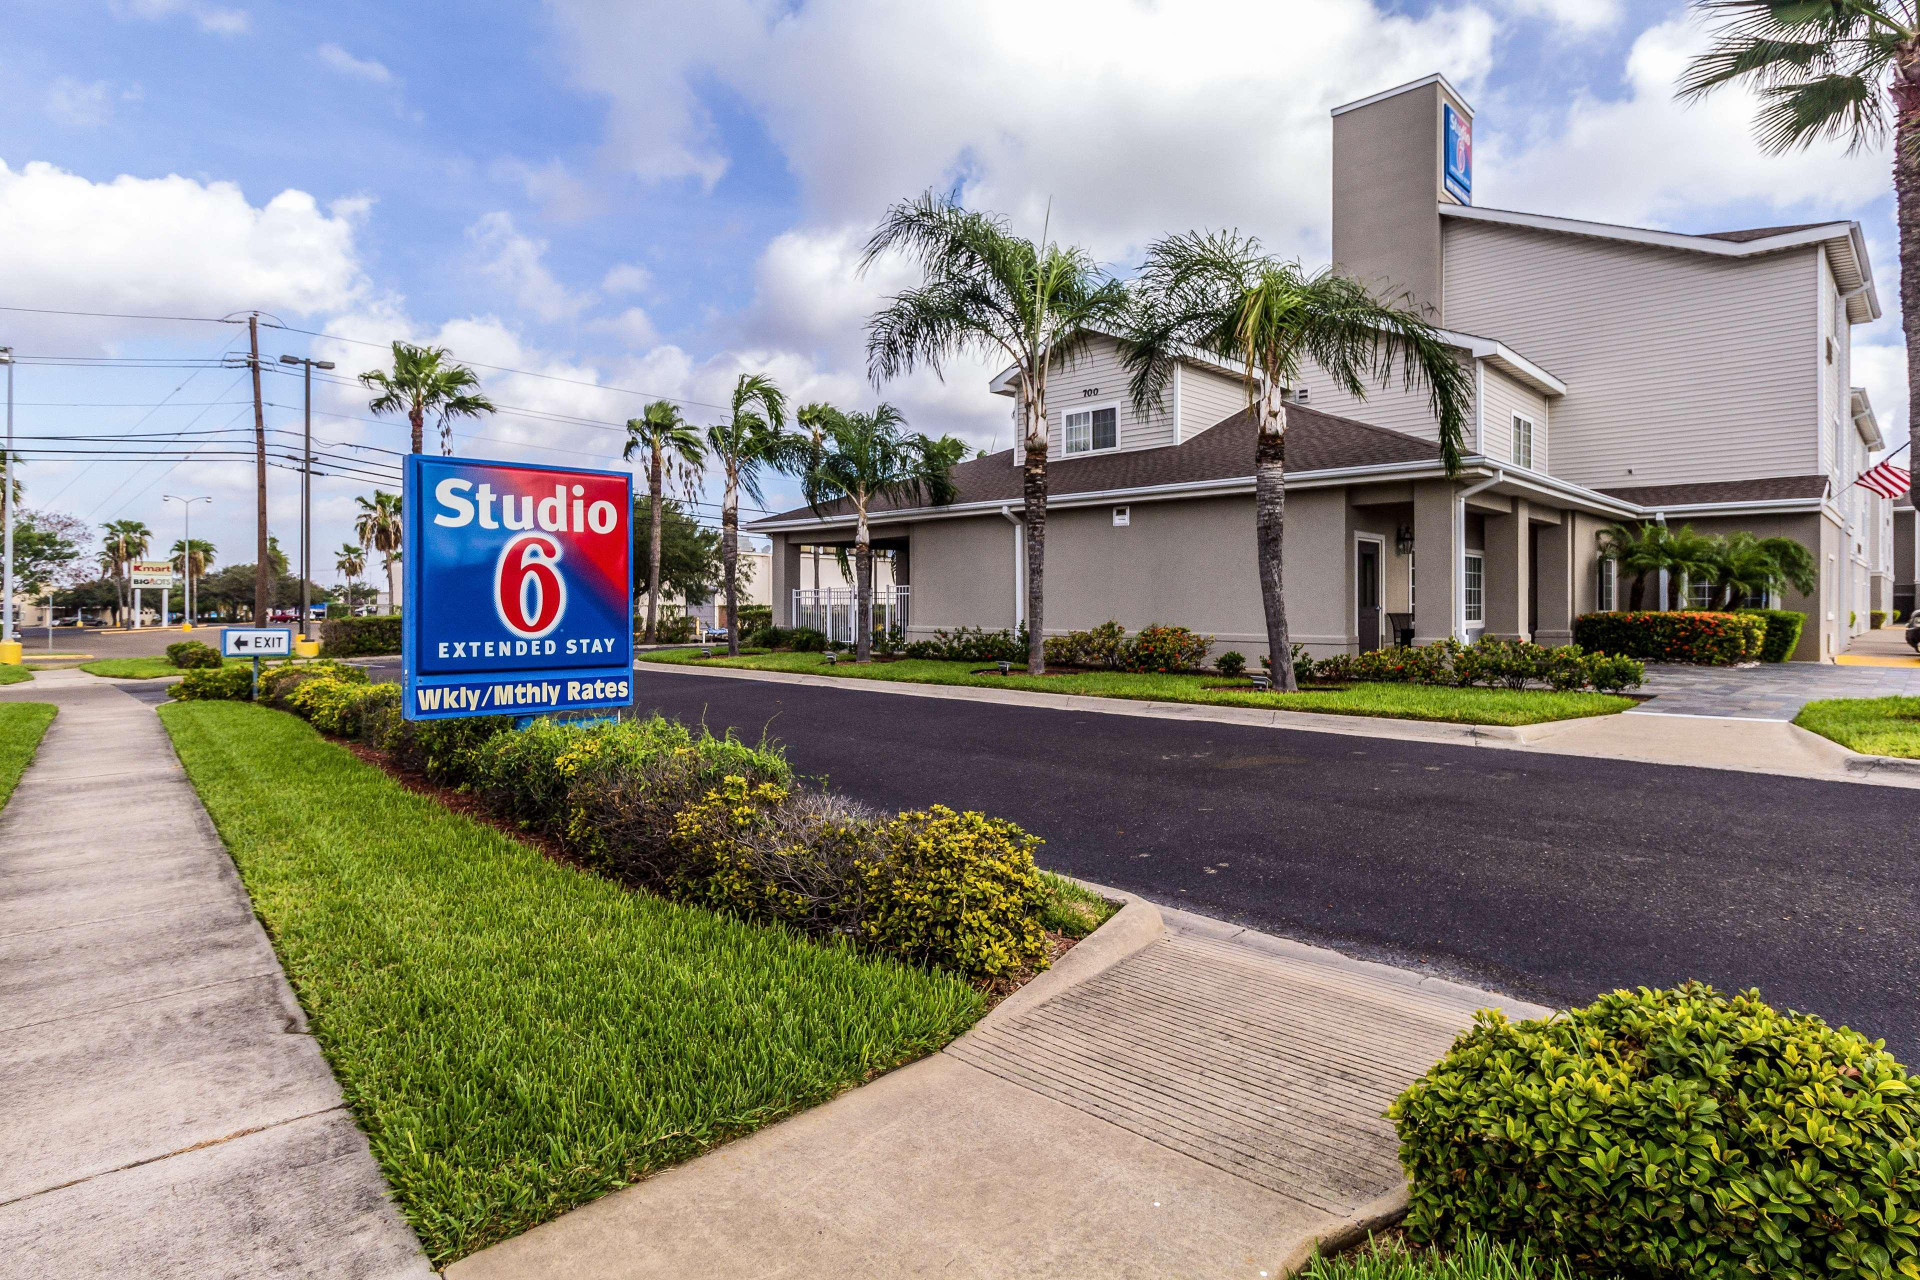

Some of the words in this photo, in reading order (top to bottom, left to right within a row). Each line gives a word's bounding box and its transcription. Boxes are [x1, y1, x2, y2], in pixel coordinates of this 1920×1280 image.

[1083, 388, 1099, 398] 700
[434, 478, 617, 534] Studio
[498, 533, 563, 636] 6
[254, 636, 283, 648] EXIT
[438, 640, 556, 658] EXTENDED
[566, 638, 615, 655] STAY
[417, 682, 560, 711] Wkly/Mthly
[567, 680, 628, 701] Rates
